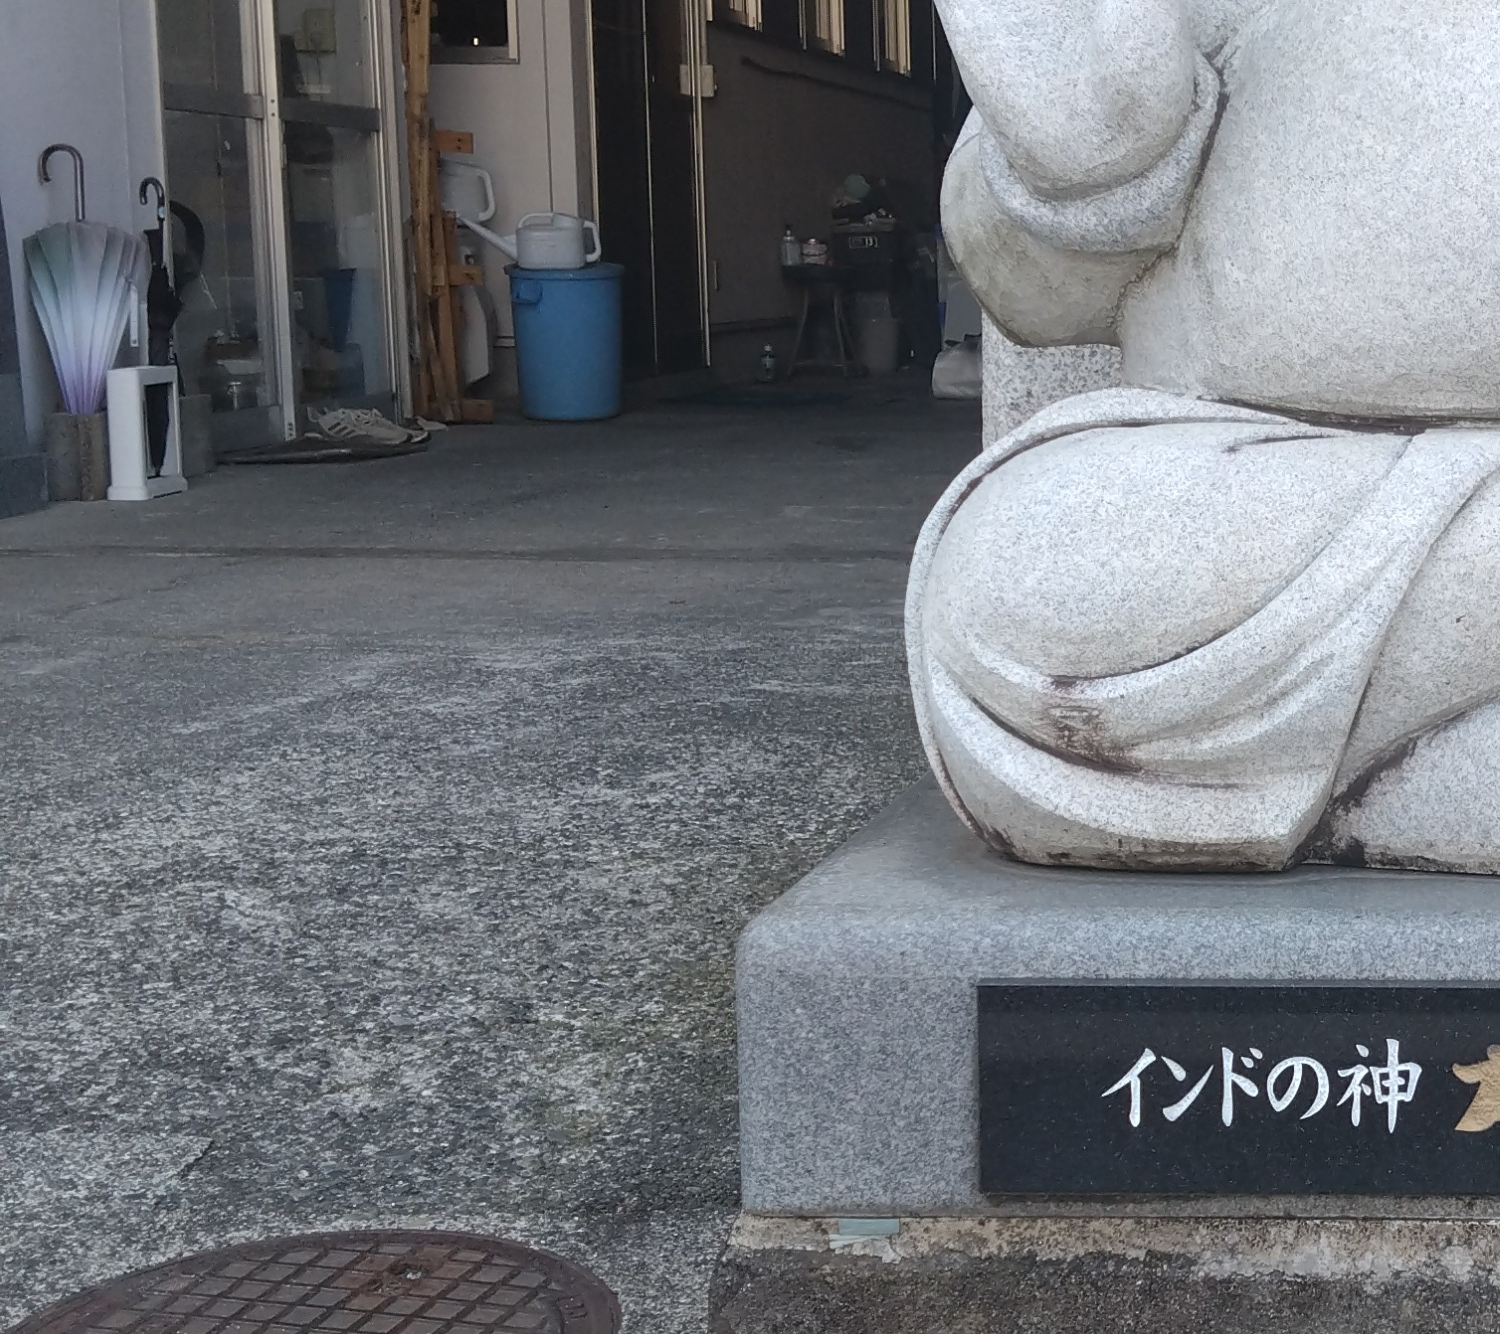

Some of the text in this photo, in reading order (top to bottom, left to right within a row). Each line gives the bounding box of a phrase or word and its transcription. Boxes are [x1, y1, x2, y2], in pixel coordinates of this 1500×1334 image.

[1101, 1038, 1423, 1134] インドの神
